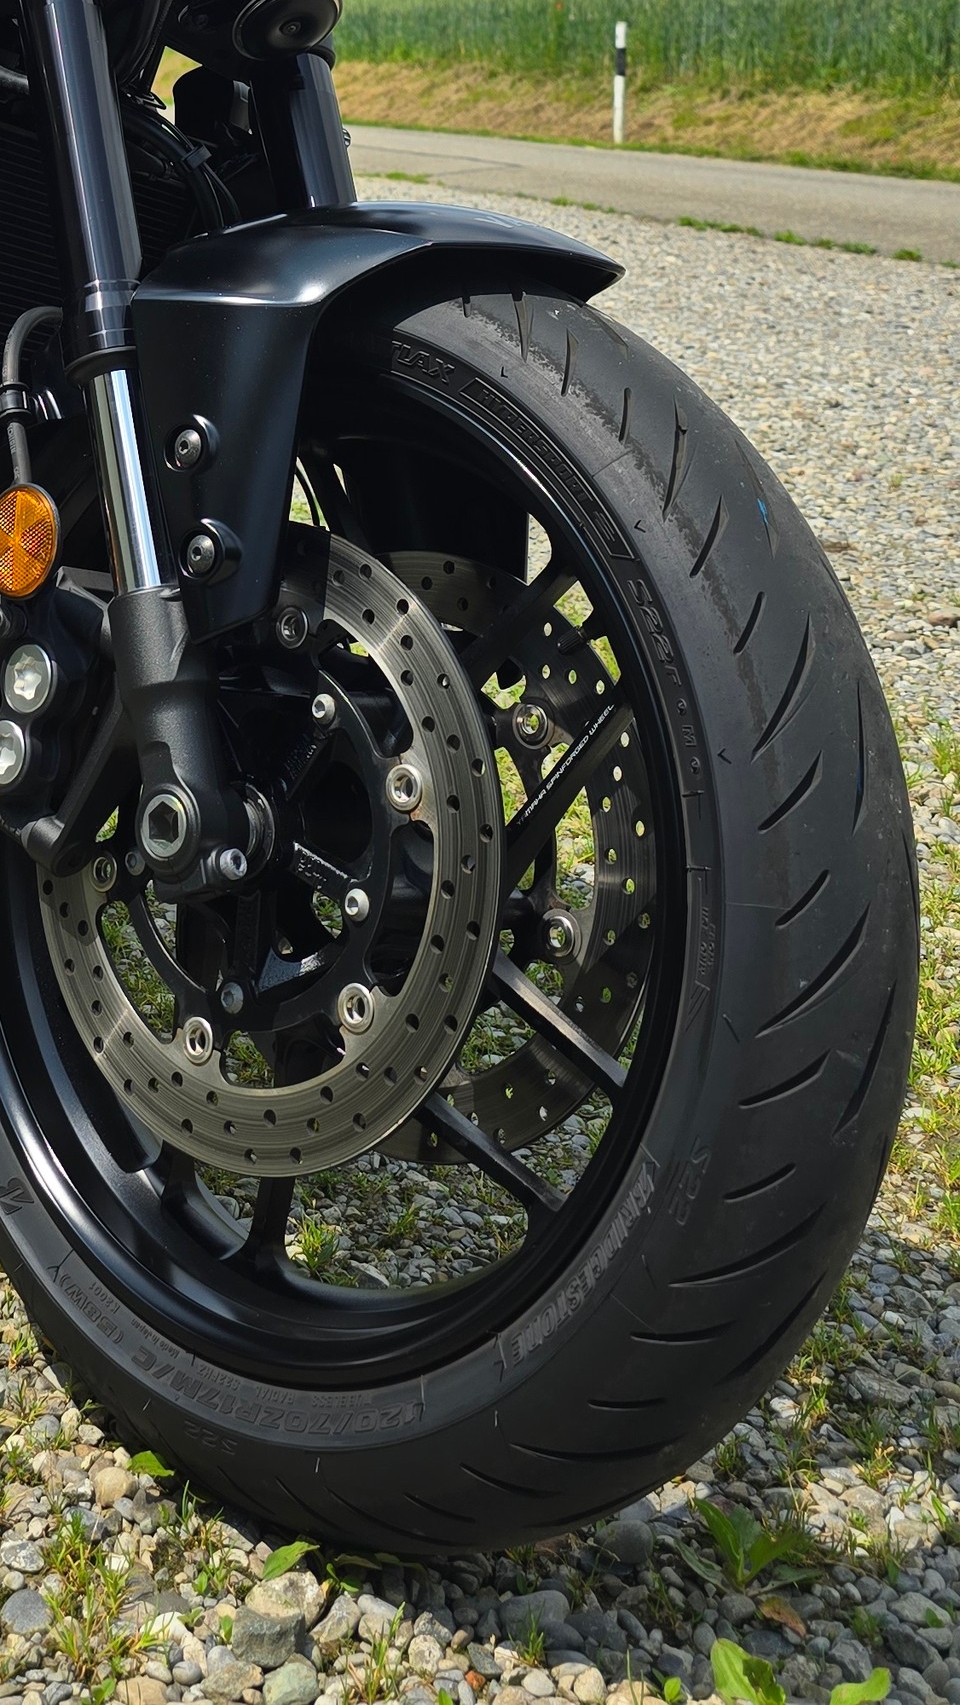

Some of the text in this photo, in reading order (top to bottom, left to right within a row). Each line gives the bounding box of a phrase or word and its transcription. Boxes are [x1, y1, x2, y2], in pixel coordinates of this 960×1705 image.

[474, 388, 594, 502] HYPERSPORT
[588, 703, 616, 736] WHEEL
[667, 1135, 713, 1227] S22
[512, 1161, 656, 1366] BRIDGESTONE
